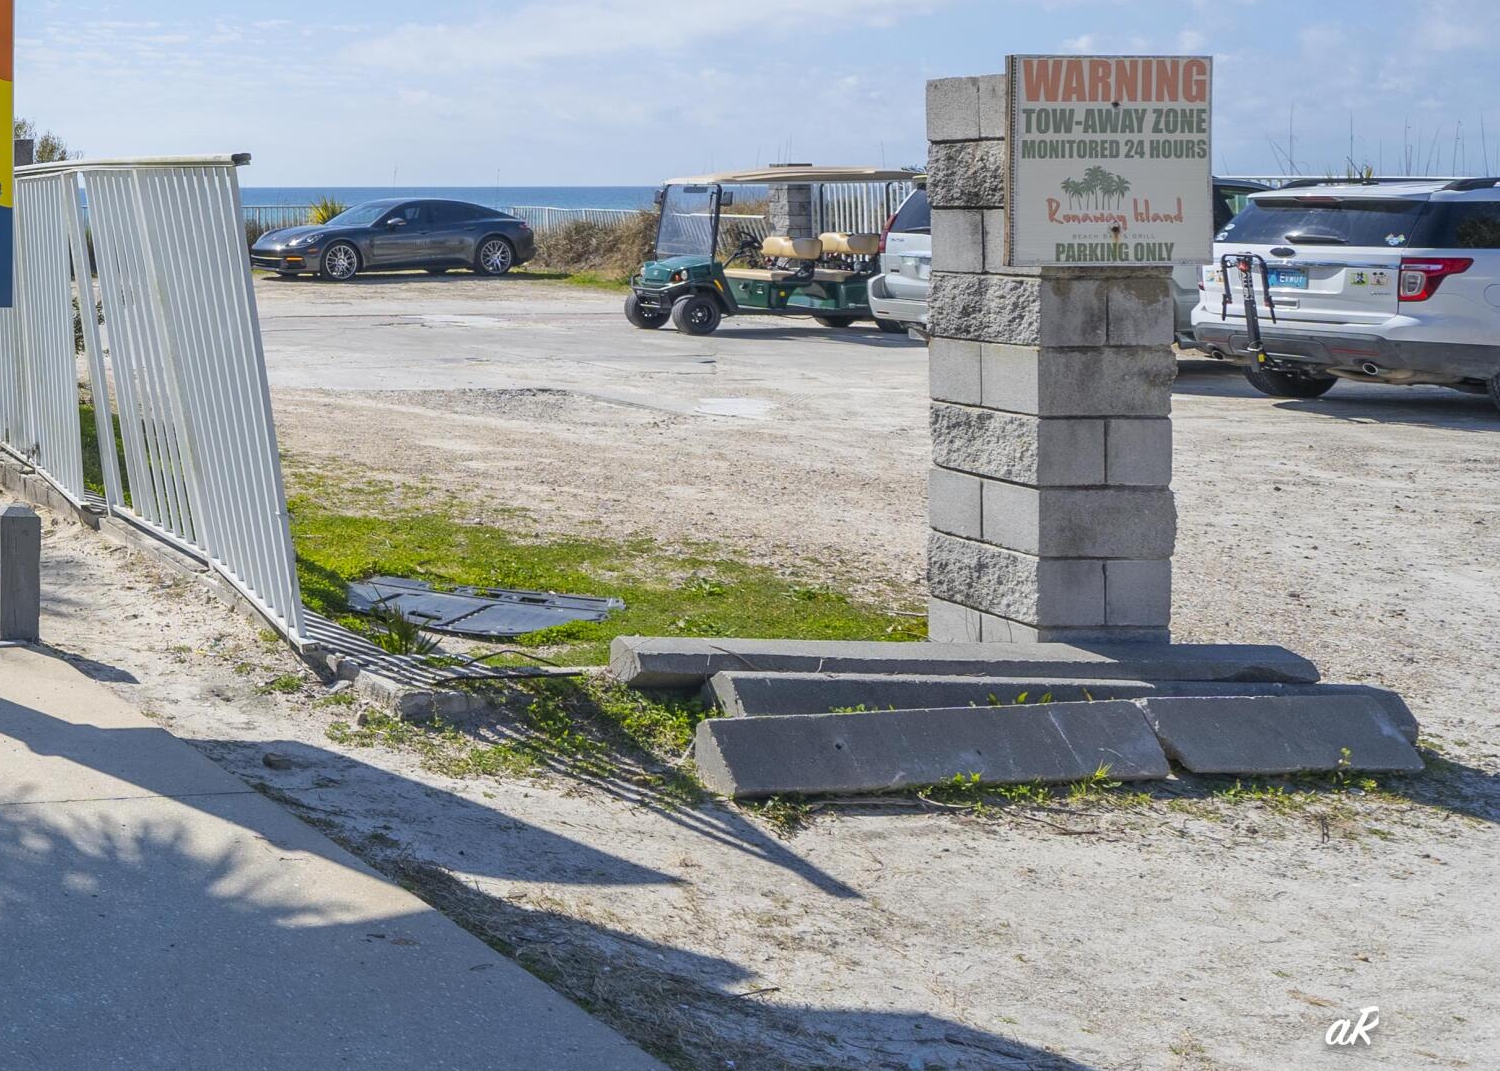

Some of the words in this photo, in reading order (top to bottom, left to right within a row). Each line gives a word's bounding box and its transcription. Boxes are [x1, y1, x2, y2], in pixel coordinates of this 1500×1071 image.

[1023, 58, 1207, 103] WARNING
[1022, 107, 1148, 135] TOW-AWAY
[1151, 107, 1207, 135] ZONE
[1021, 139, 1120, 159] MONITORED
[1124, 139, 1145, 159] 24
[1149, 139, 1207, 159] HOURS
[1132, 197, 1184, 224] Island
[1055, 242, 1130, 262] PARKING
[1133, 242, 1175, 262] ONLY
